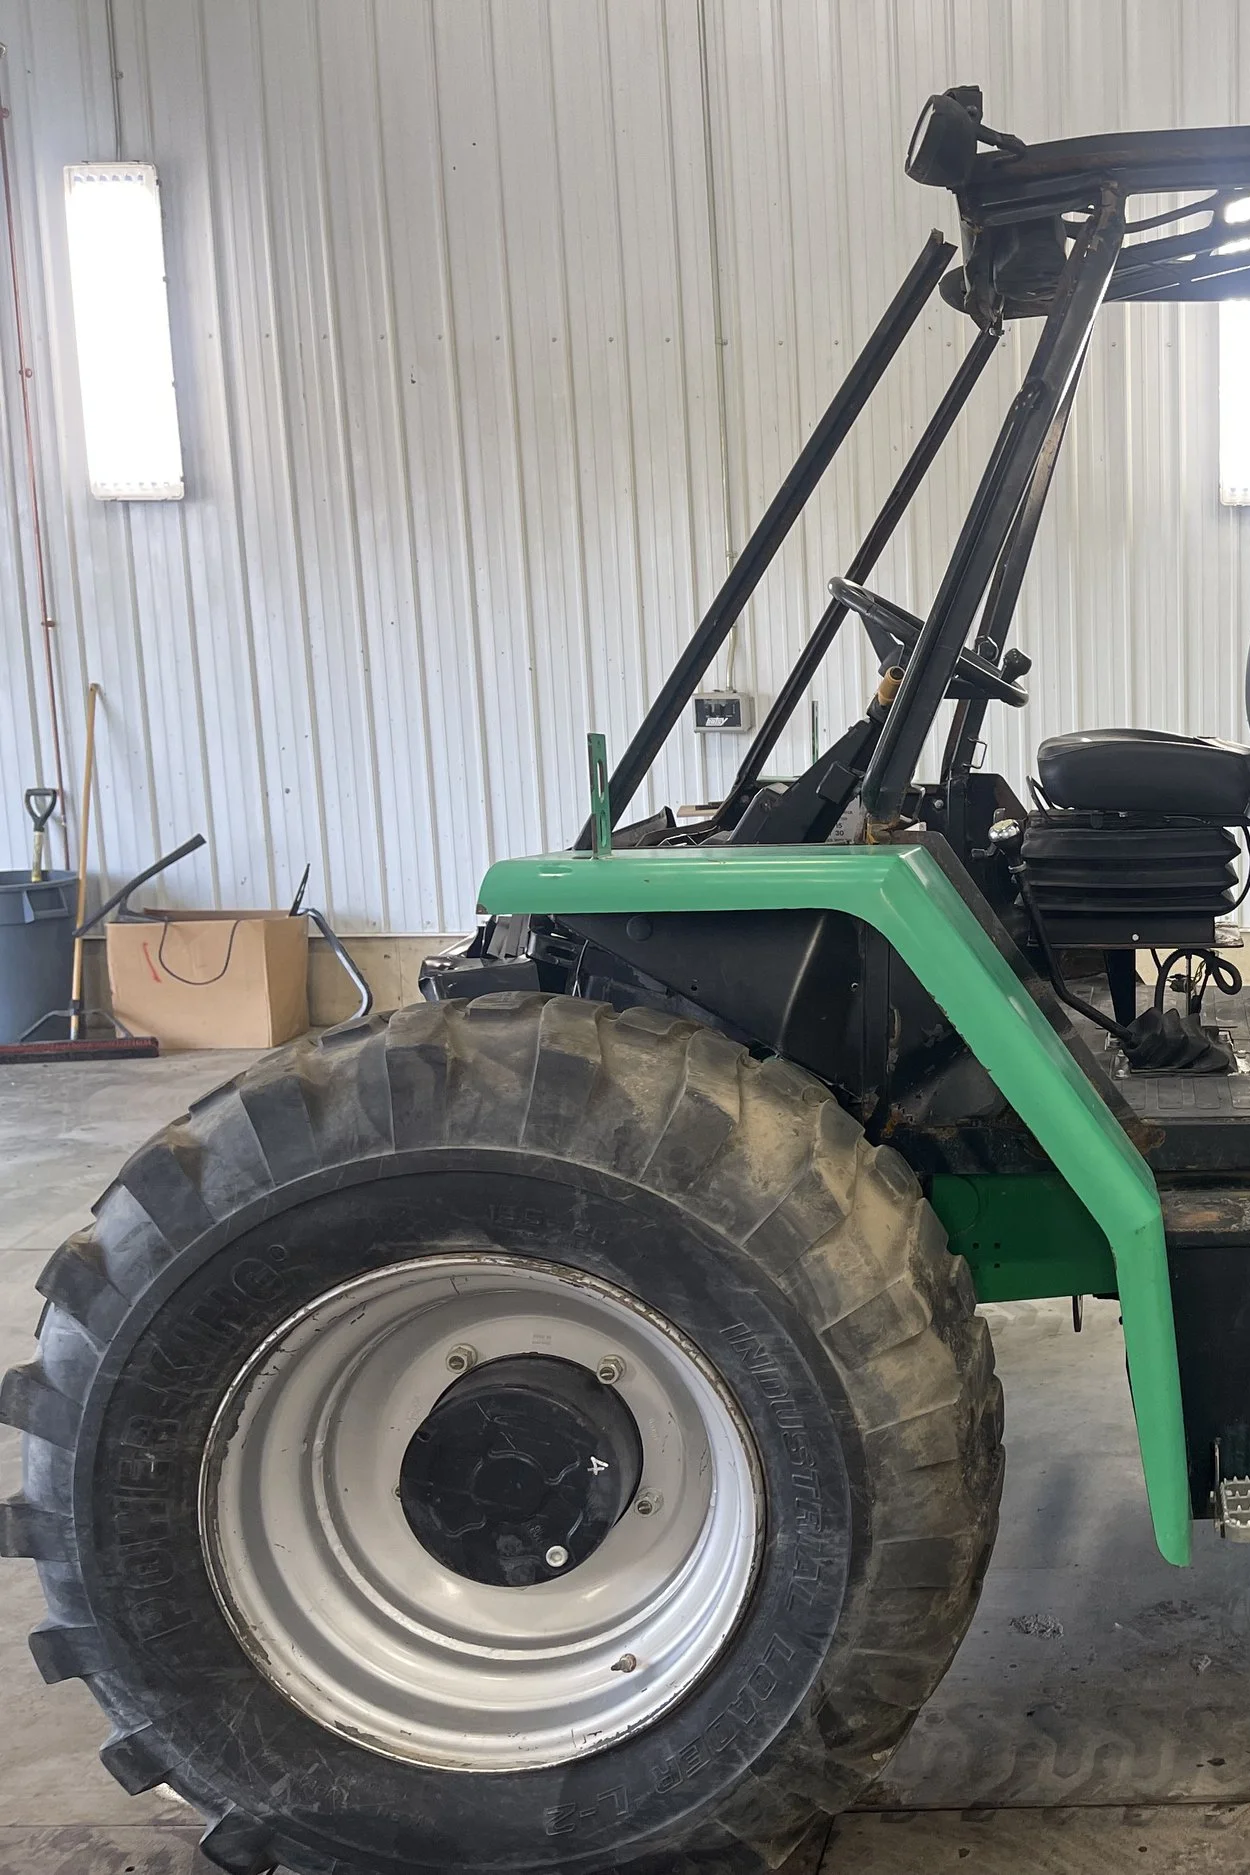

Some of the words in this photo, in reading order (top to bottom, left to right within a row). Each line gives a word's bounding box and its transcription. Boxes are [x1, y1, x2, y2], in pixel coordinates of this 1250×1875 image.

[718, 1322, 823, 1612] INDUSTRIAL
[652, 1632, 797, 1795] LOADER
[544, 1784, 632, 1836] L-2
